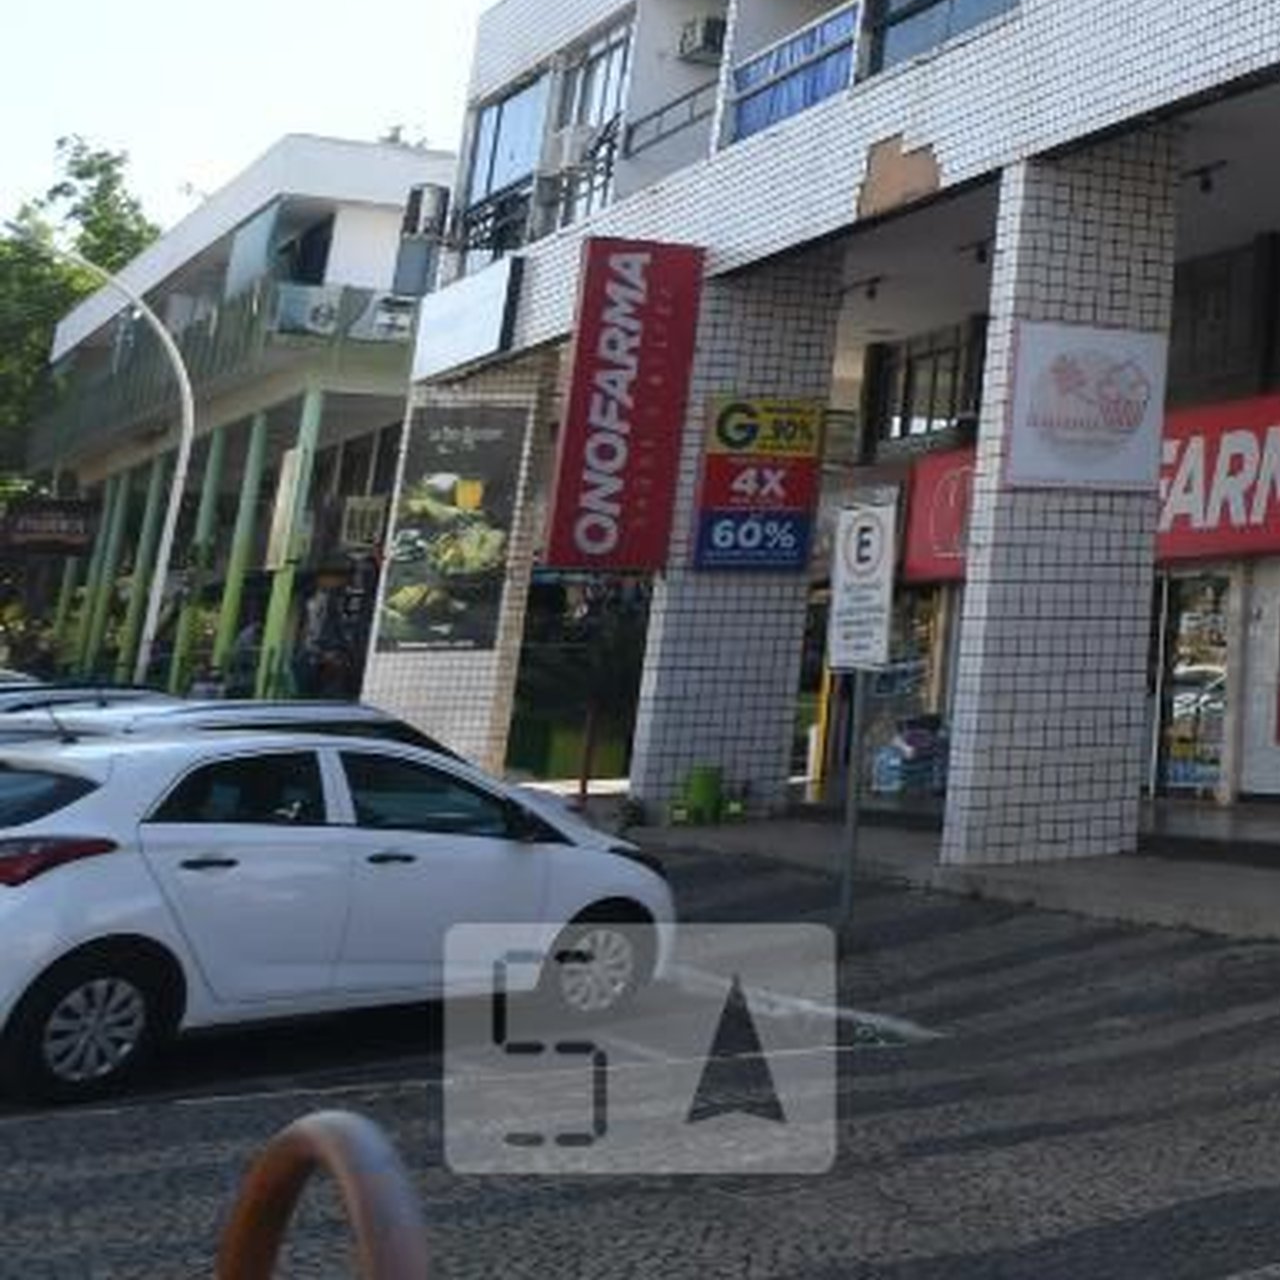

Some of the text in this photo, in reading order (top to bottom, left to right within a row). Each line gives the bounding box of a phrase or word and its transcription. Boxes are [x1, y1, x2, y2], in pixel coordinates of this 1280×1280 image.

[575, 252, 652, 556] ONOFARMA
[729, 466, 787, 498] 4X
[712, 518, 797, 549] 60%
[855, 526, 873, 564] E
